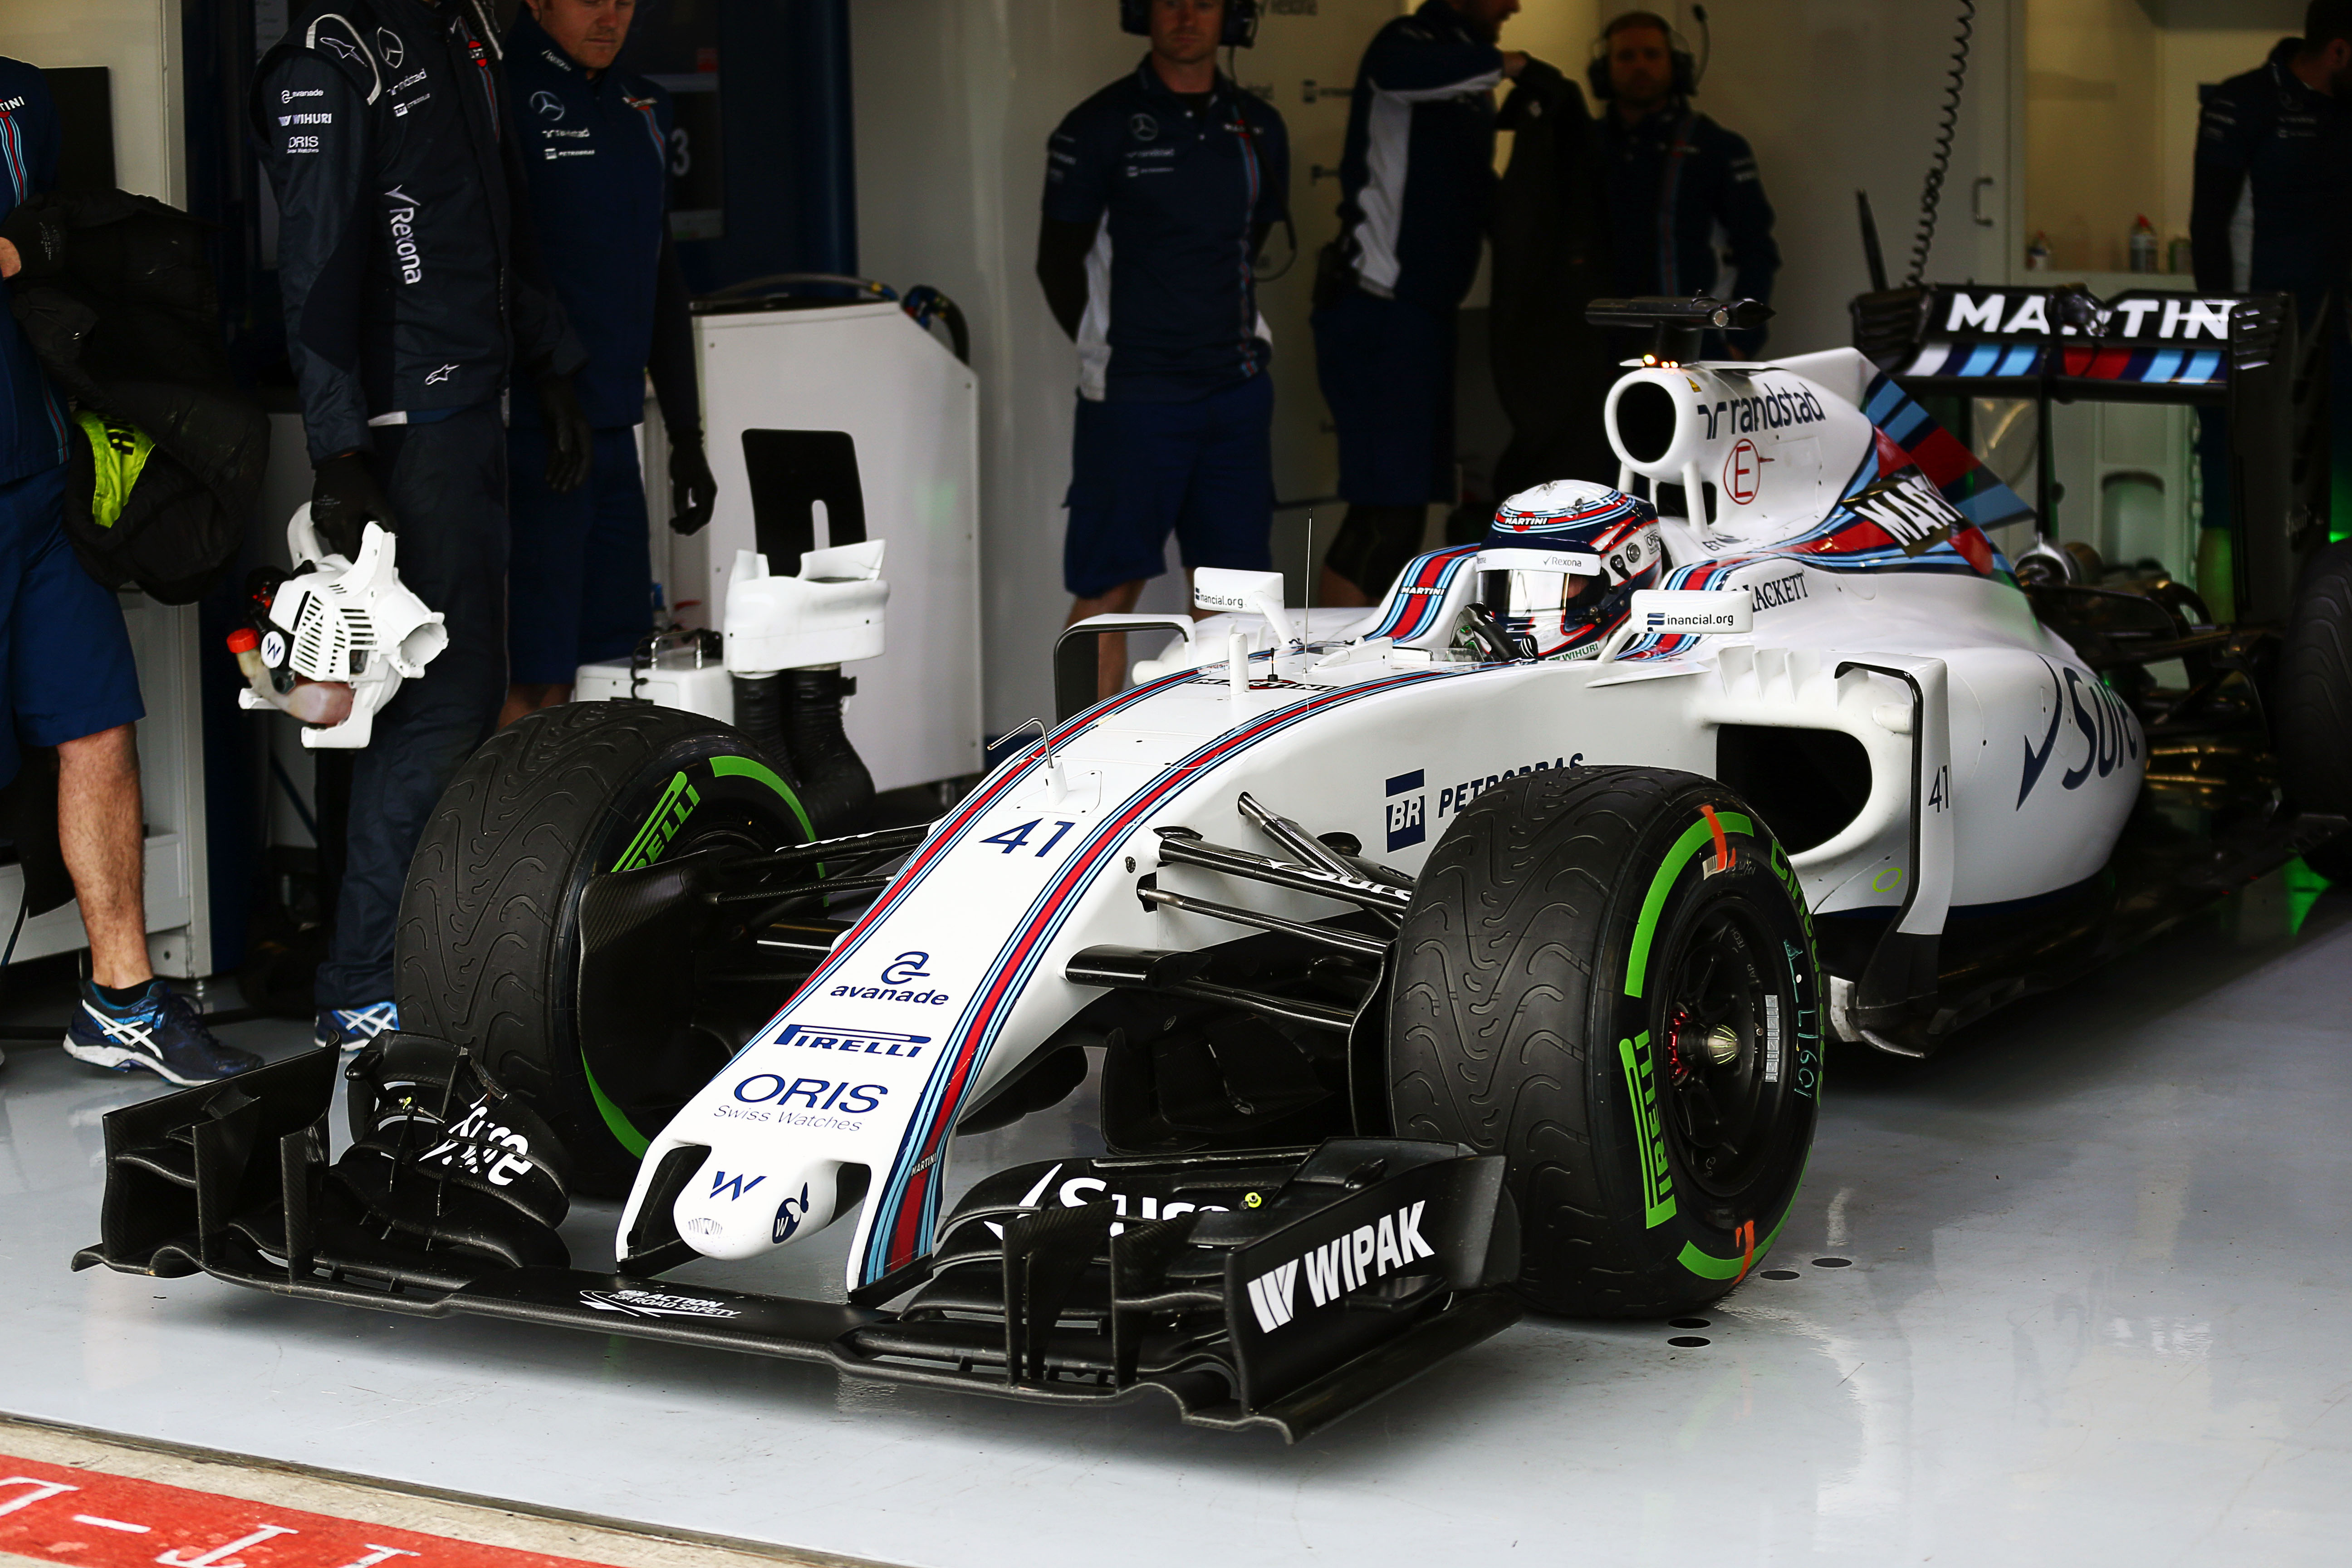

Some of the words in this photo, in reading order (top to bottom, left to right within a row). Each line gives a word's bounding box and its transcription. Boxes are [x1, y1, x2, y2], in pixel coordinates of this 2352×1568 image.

[288, 136, 319, 148] ORIS
[670, 127, 691, 176] 3
[389, 207, 422, 285] Rexona
[1946, 293, 2234, 339] MATIN
[1730, 382, 1826, 435] randstad
[1735, 445, 1754, 498] E
[1504, 517, 1548, 525] MARTINI
[1552, 557, 1582, 568] Rexona
[1401, 586, 1446, 596] MARTINI
[1561, 642, 1598, 661] WIHURI
[1190, 678, 1333, 691] MRTINI
[1928, 764, 1949, 813] 41
[978, 818, 1076, 858] 41
[830, 985, 950, 1005] avanade
[773, 1024, 932, 1058] PIRELLI
[734, 1073, 889, 1113] ORIS
[714, 1105, 771, 1123] Swiss
[777, 1111, 863, 1132] Watches
[1619, 1029, 1677, 1230] PIRELLI
[911, 1153, 937, 1176] MARTINI
[1304, 1200, 1435, 1308] WIPAK
[630, 1297, 675, 1308] ROAD
[675, 1303, 742, 1317] SAFETY
[645, 1294, 725, 1308] ACTION
